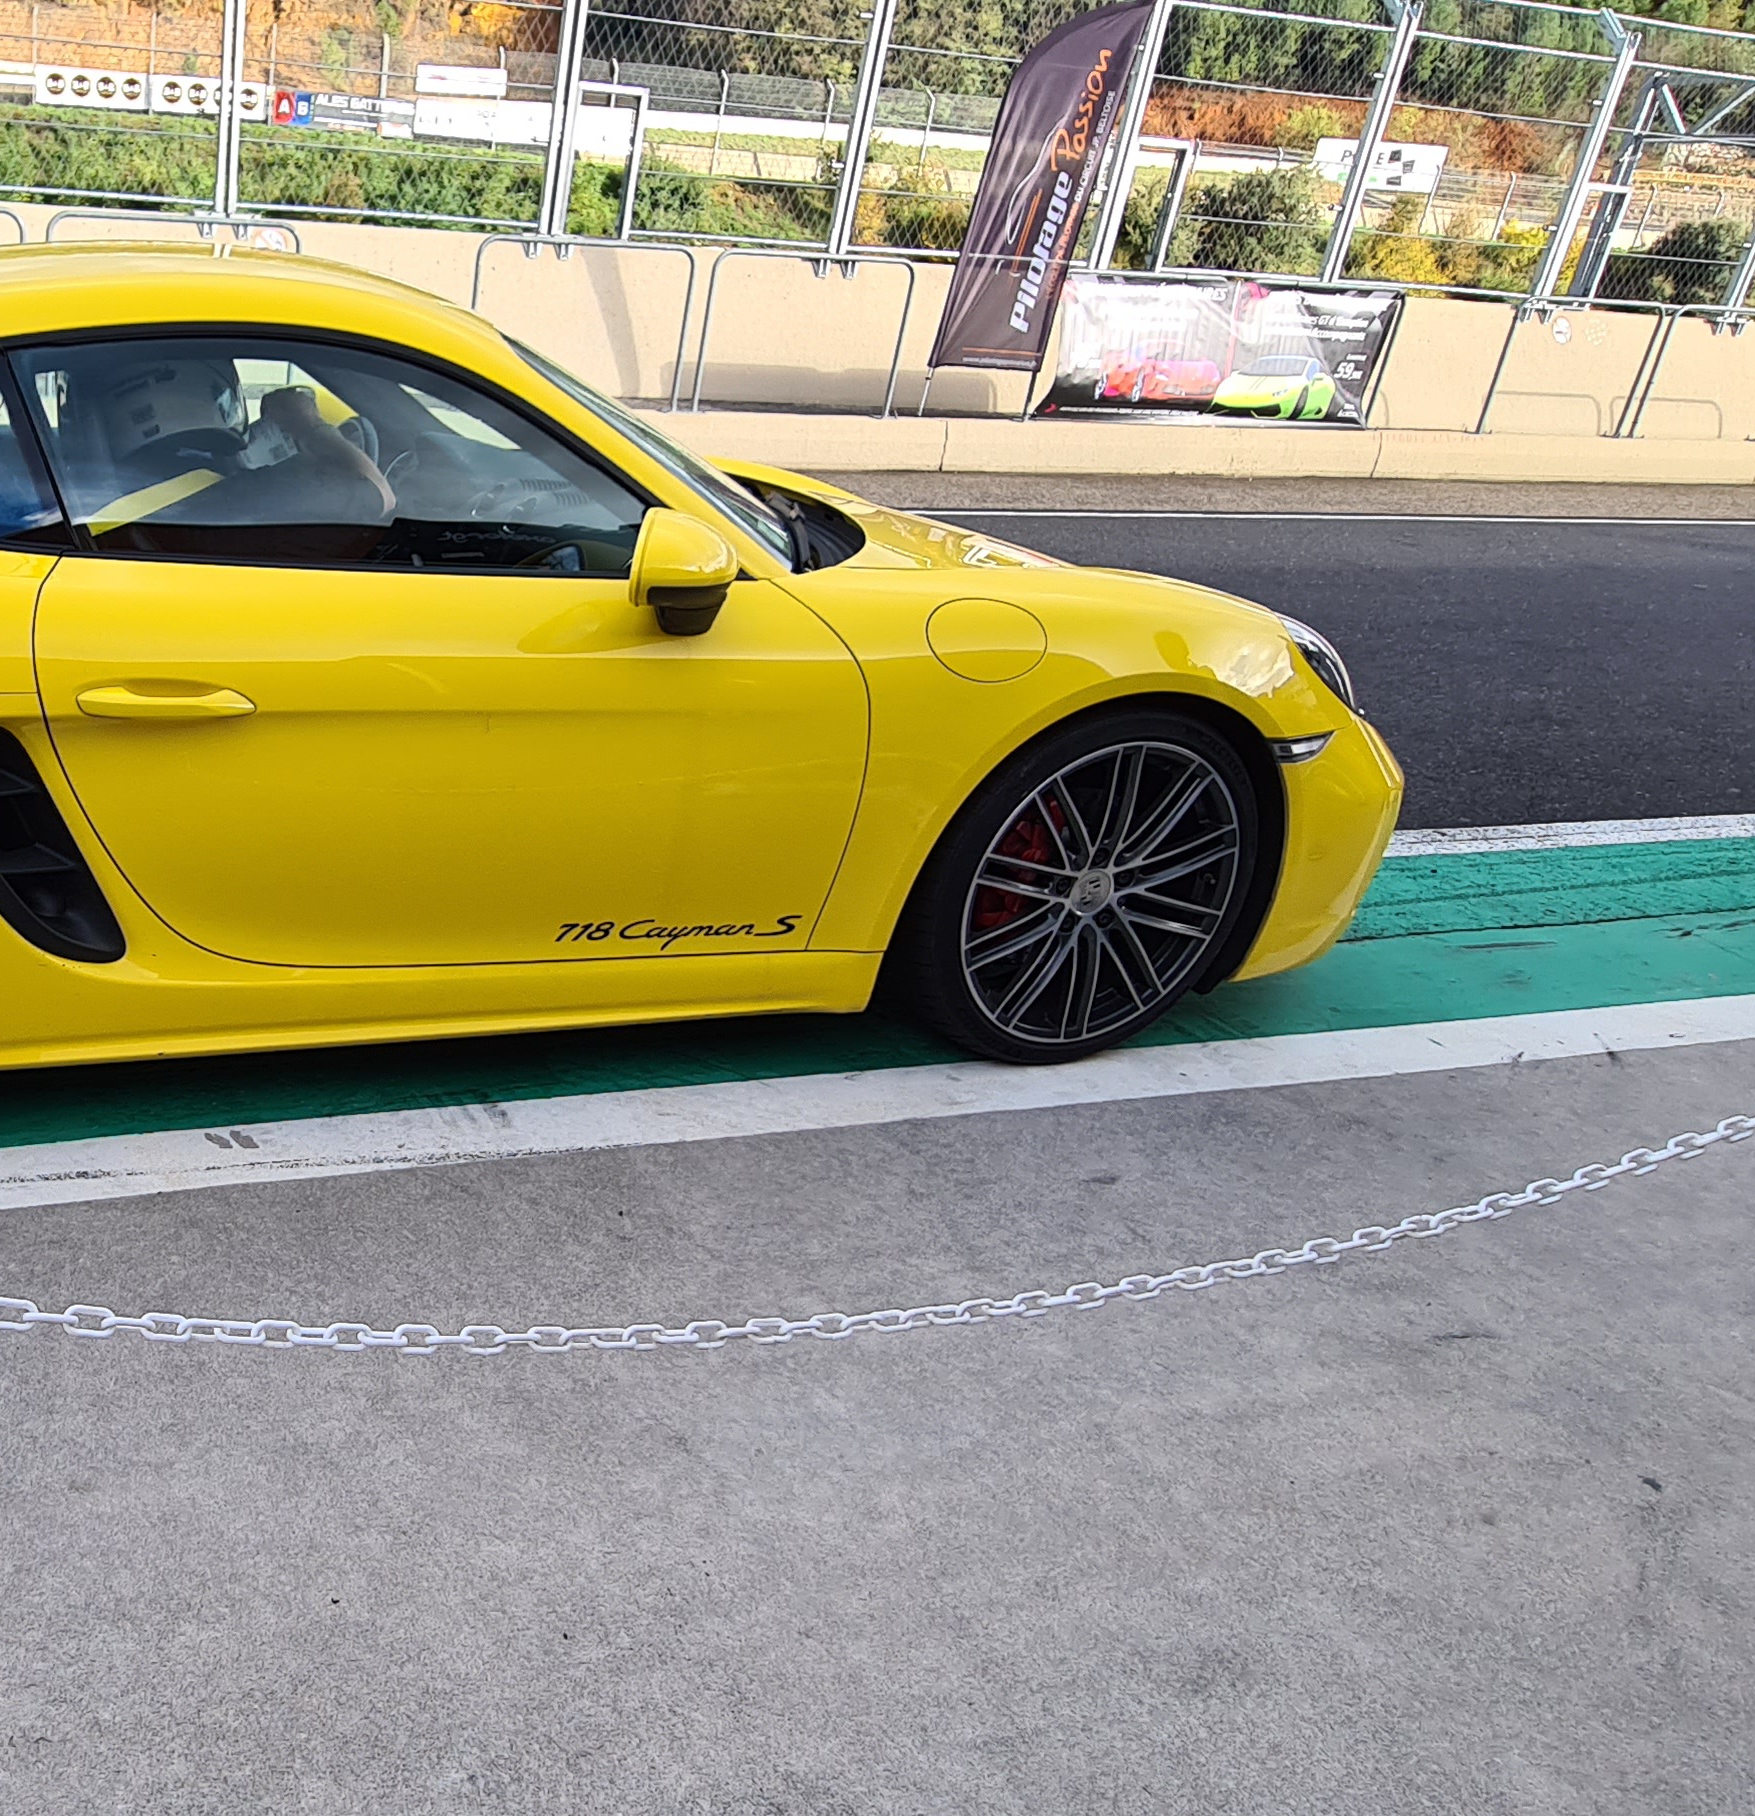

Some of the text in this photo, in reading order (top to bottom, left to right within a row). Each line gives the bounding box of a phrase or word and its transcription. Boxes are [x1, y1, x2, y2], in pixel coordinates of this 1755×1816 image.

[1050, 49, 1113, 172] Passion
[1080, 149, 1097, 186] CIRCUIT
[1096, 90, 1116, 134] BELTOISE
[554, 915, 803, 951] 718 Cayman S
